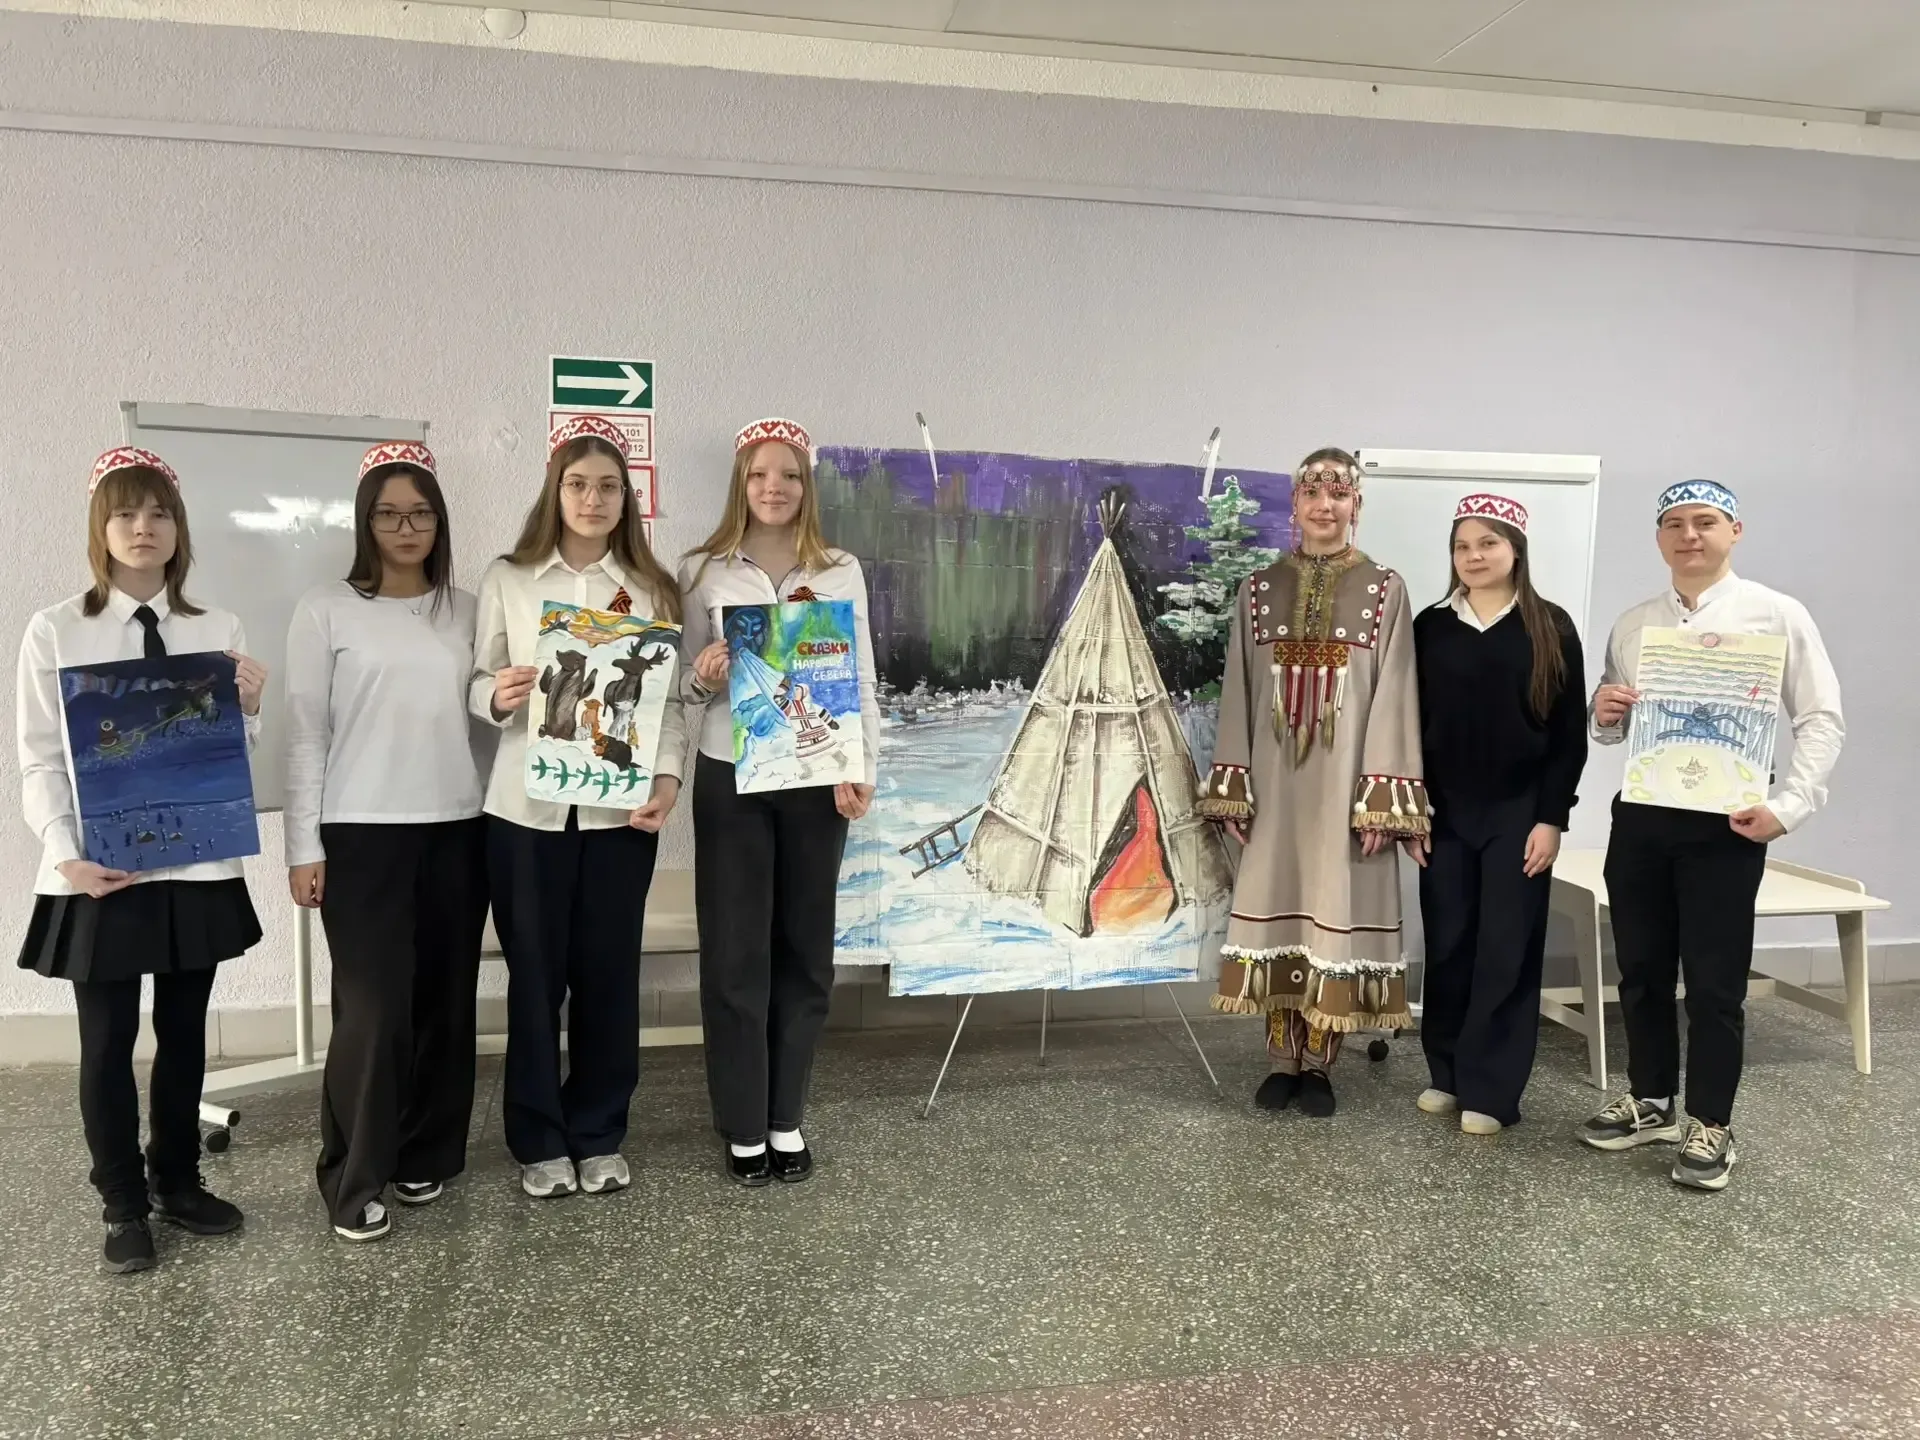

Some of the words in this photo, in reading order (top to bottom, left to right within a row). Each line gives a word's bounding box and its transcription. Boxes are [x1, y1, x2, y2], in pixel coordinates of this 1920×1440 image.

[626, 428, 640, 437] 101
[629, 444, 644, 453] 112
[797, 641, 849, 655] СКАЗКИ
[812, 669, 852, 682] СЕВЕРА
